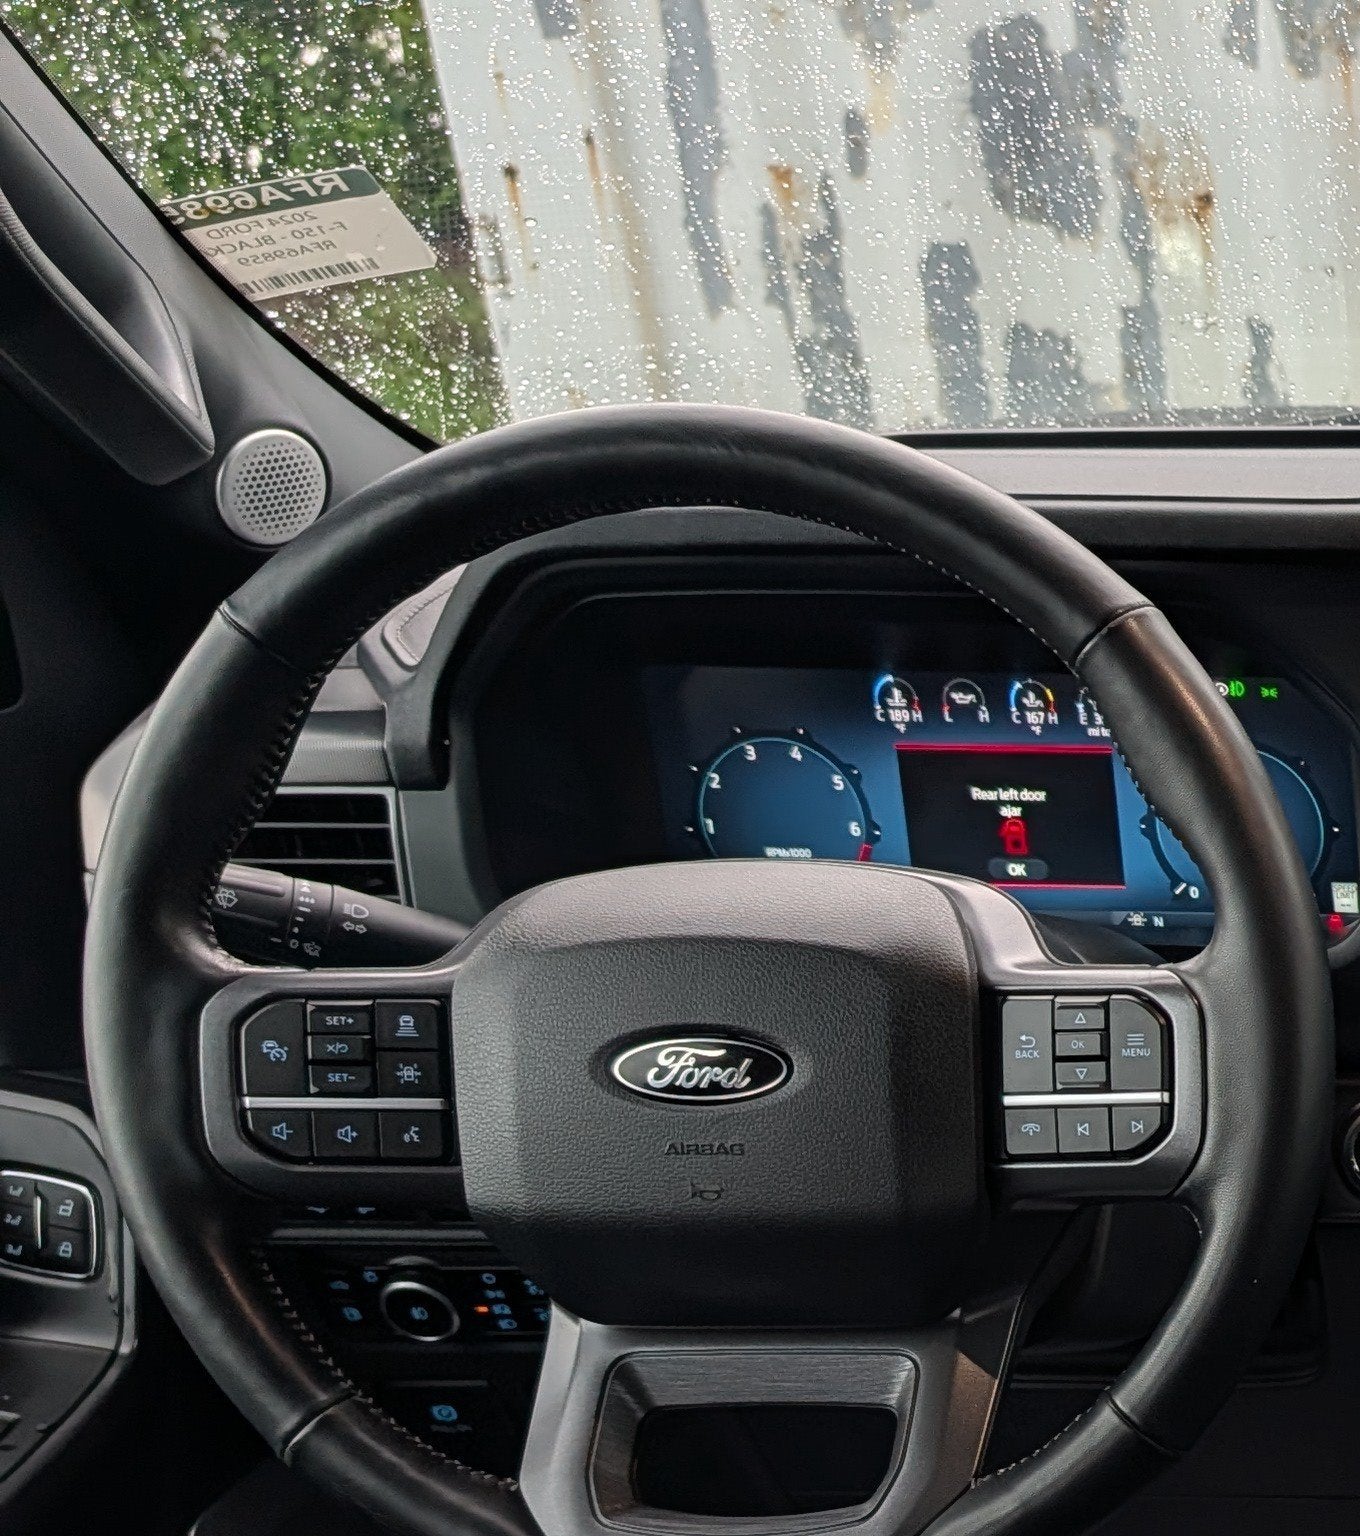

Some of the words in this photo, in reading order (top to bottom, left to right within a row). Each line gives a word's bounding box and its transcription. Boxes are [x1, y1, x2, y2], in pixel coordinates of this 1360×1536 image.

[744, 744, 757, 762] 3
[789, 745, 803, 762] 4
[708, 772, 722, 790] 2
[832, 773, 845, 791] 5
[970, 786, 997, 801] Rear
[998, 786, 1018, 801] left
[1019, 788, 1047, 802] door
[999, 804, 1023, 818] ajar
[704, 817, 716, 835] 1
[849, 821, 862, 837] 6
[1006, 863, 1028, 877] OK
[1071, 1039, 1086, 1050] OK
[1015, 1049, 1040, 1059] BACK
[1121, 1048, 1151, 1058] MENU
[647, 1046, 754, 1090] Ford
[664, 1142, 746, 1157] AIRBAG
